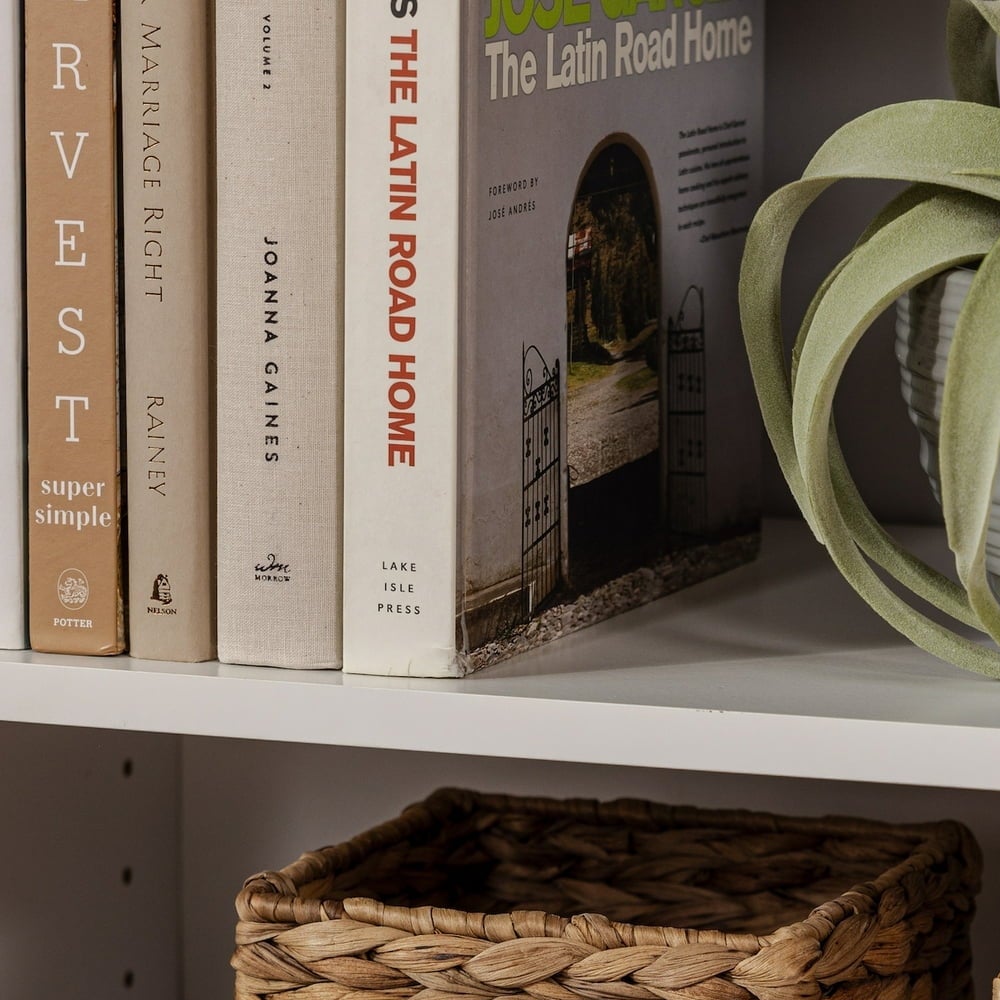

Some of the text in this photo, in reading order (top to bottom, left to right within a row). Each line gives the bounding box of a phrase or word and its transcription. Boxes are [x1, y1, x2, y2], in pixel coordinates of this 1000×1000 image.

[262, 14, 271, 76] VOLUME
[390, 29, 418, 104] THE
[484, 40, 538, 100] The
[546, 27, 608, 90] Latin
[615, 13, 677, 77] Road
[684, 10, 753, 64] Home
[141, 23, 164, 302] MARRIAGE RIGHT
[389, 115, 417, 221] LATIN
[488, 177, 539, 197] FOREWORD BY
[50, 0, 89, 442] RVEST
[388, 233, 417, 343] ROAD
[264, 237, 279, 462] JOANNA GAINES
[387, 354, 416, 467] HOME
[147, 396, 166, 496] RAINEY
[35, 503, 112, 531] simple
[41, 479, 106, 501] super
[254, 574, 291, 582] MORROW
[382, 561, 417, 572] LAKE
[384, 582, 414, 593] ISLE
[53, 617, 93, 628] POTTER
[147, 606, 177, 615] NELSON
[377, 603, 421, 615] PRESS
